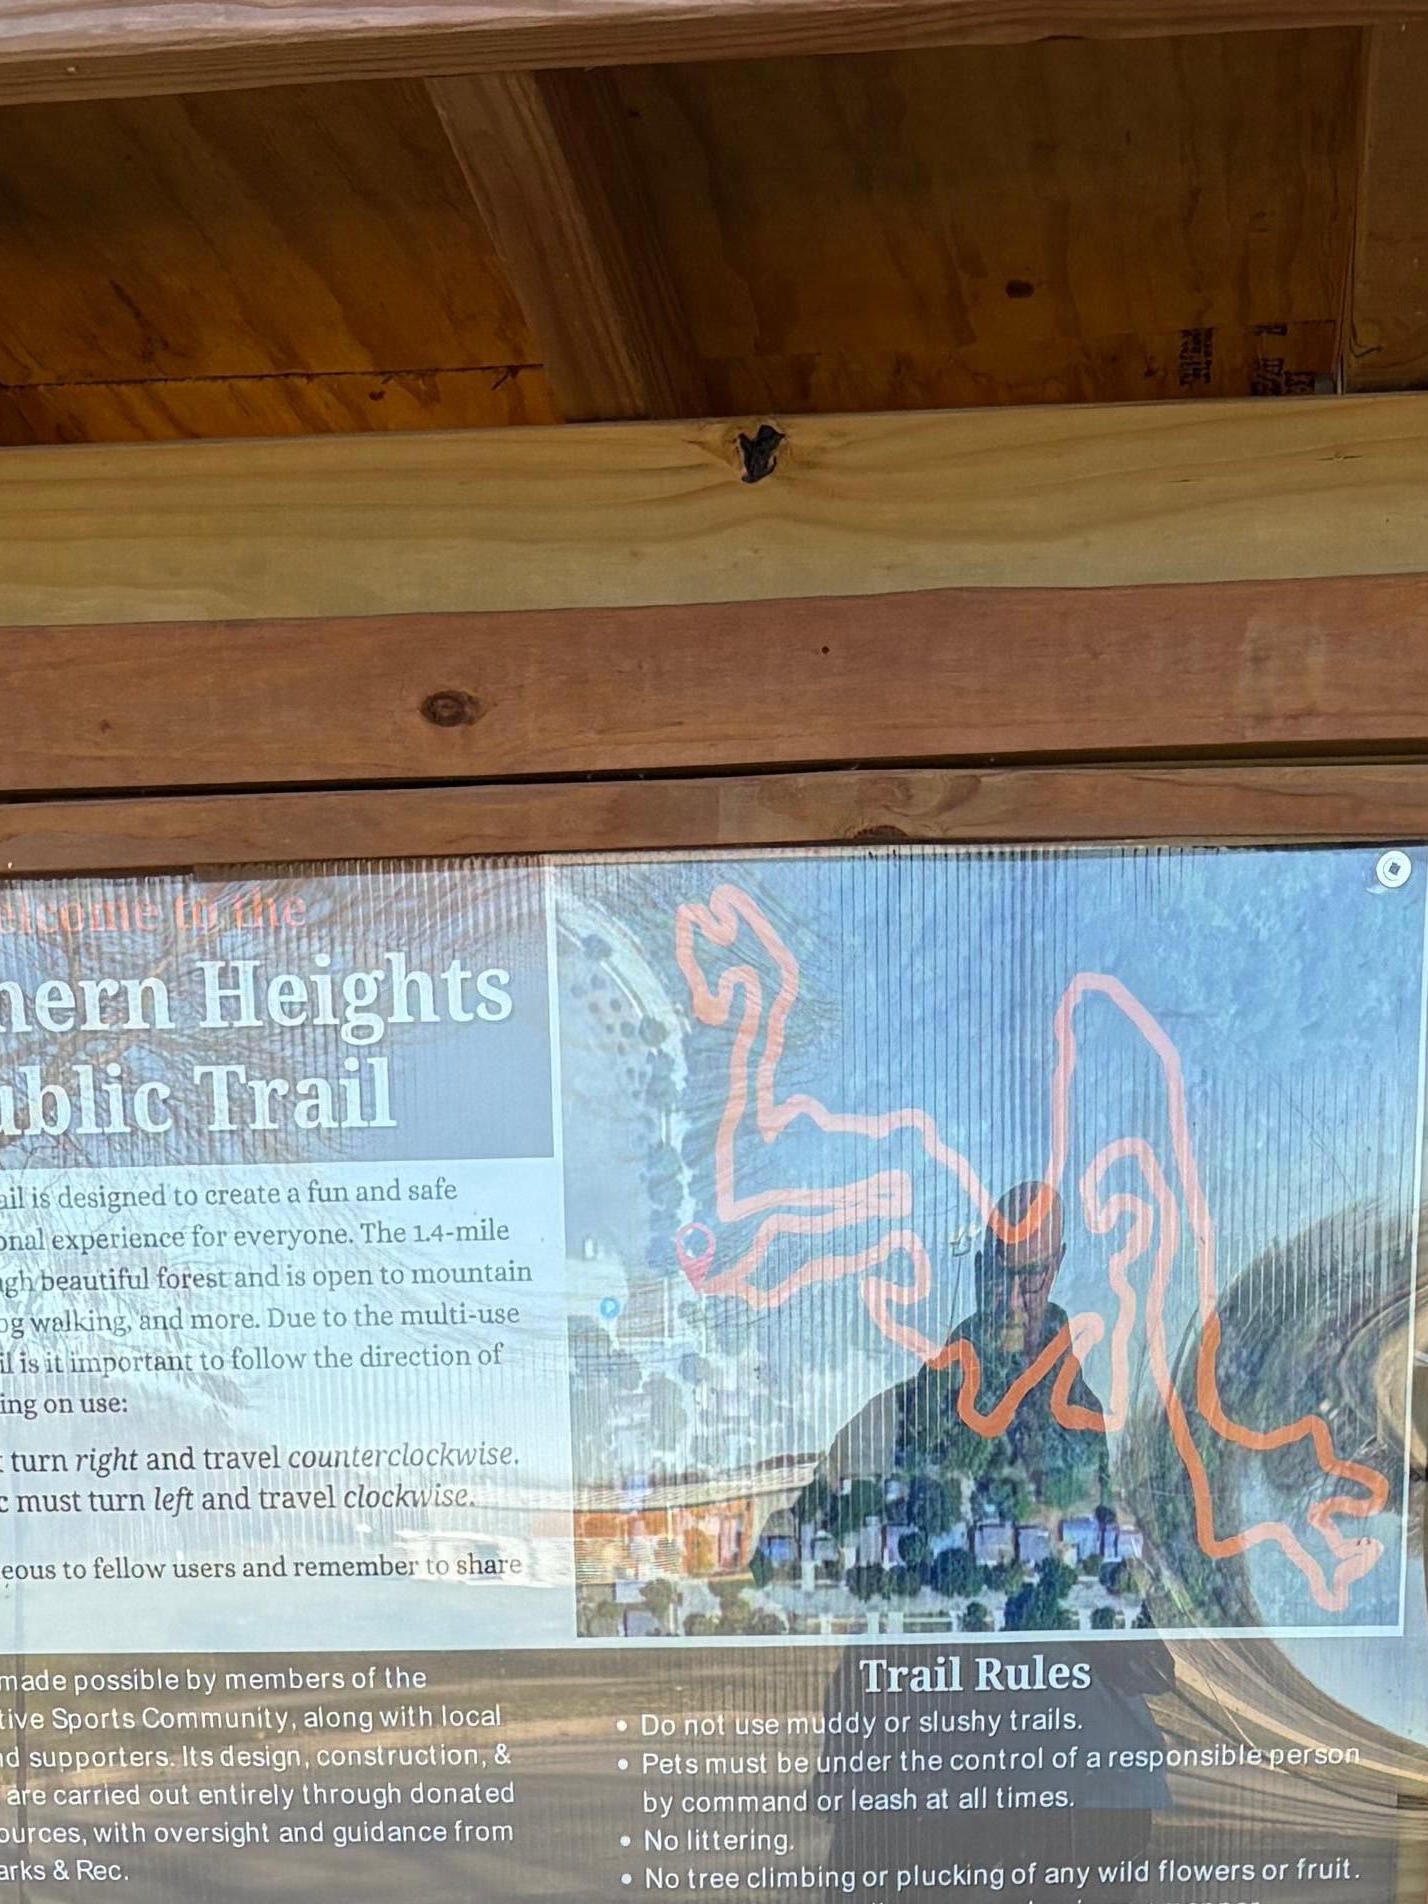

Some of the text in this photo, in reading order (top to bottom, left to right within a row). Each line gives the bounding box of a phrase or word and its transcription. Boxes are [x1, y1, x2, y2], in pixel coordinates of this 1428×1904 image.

[175, 895, 218, 929] to
[234, 888, 307, 929] the
[198, 951, 514, 1047] Heights
[193, 1057, 398, 1132] Trail
[31, 1188, 51, 1210] is
[58, 1184, 167, 1215] designed
[173, 1187, 199, 1207] to
[204, 1187, 281, 1206] create
[286, 1187, 301, 1205] a
[307, 1178, 349, 1203] fun
[355, 1178, 401, 1202] and
[408, 1176, 458, 1201] safe
[51, 1229, 186, 1258] experience
[191, 1224, 228, 1248] for
[233, 1228, 354, 1250] everyone.
[359, 1220, 406, 1244] The
[413, 1217, 510, 1243] 1.4-mile
[43, 1398, 74, 1414] on
[79, 1396, 128, 1414] use:
[10, 1452, 69, 1473] turn
[75, 1447, 139, 1478] right
[146, 1446, 197, 1471] and
[203, 1445, 281, 1470] travel
[288, 1442, 519, 1469] counterclockwise.
[16, 1492, 83, 1513] must
[87, 1492, 146, 1512] turn
[154, 1486, 194, 1517] left
[201, 1485, 251, 1511] and
[259, 1484, 336, 1510] travel
[343, 1483, 475, 1509] clockwise.
[74, 1668, 179, 1694] possible
[186, 1668, 217, 1695] by
[225, 1669, 345, 1690] members
[351, 1666, 377, 1689] of
[385, 1667, 427, 1689] the
[859, 1655, 1091, 1693] Trail Rules
[51, 1707, 136, 1733] Sports
[141, 1707, 297, 1736] Community,
[304, 1707, 373, 1733] along
[378, 1705, 433, 1727] with
[441, 1704, 501, 1727] local
[641, 1708, 1083, 1739] Do not use use muddy or trails.
[644, 1829, 794, 1855] No littering.
[52, 1859, 70, 1881] &
[76, 1859, 129, 1881] Rec.
